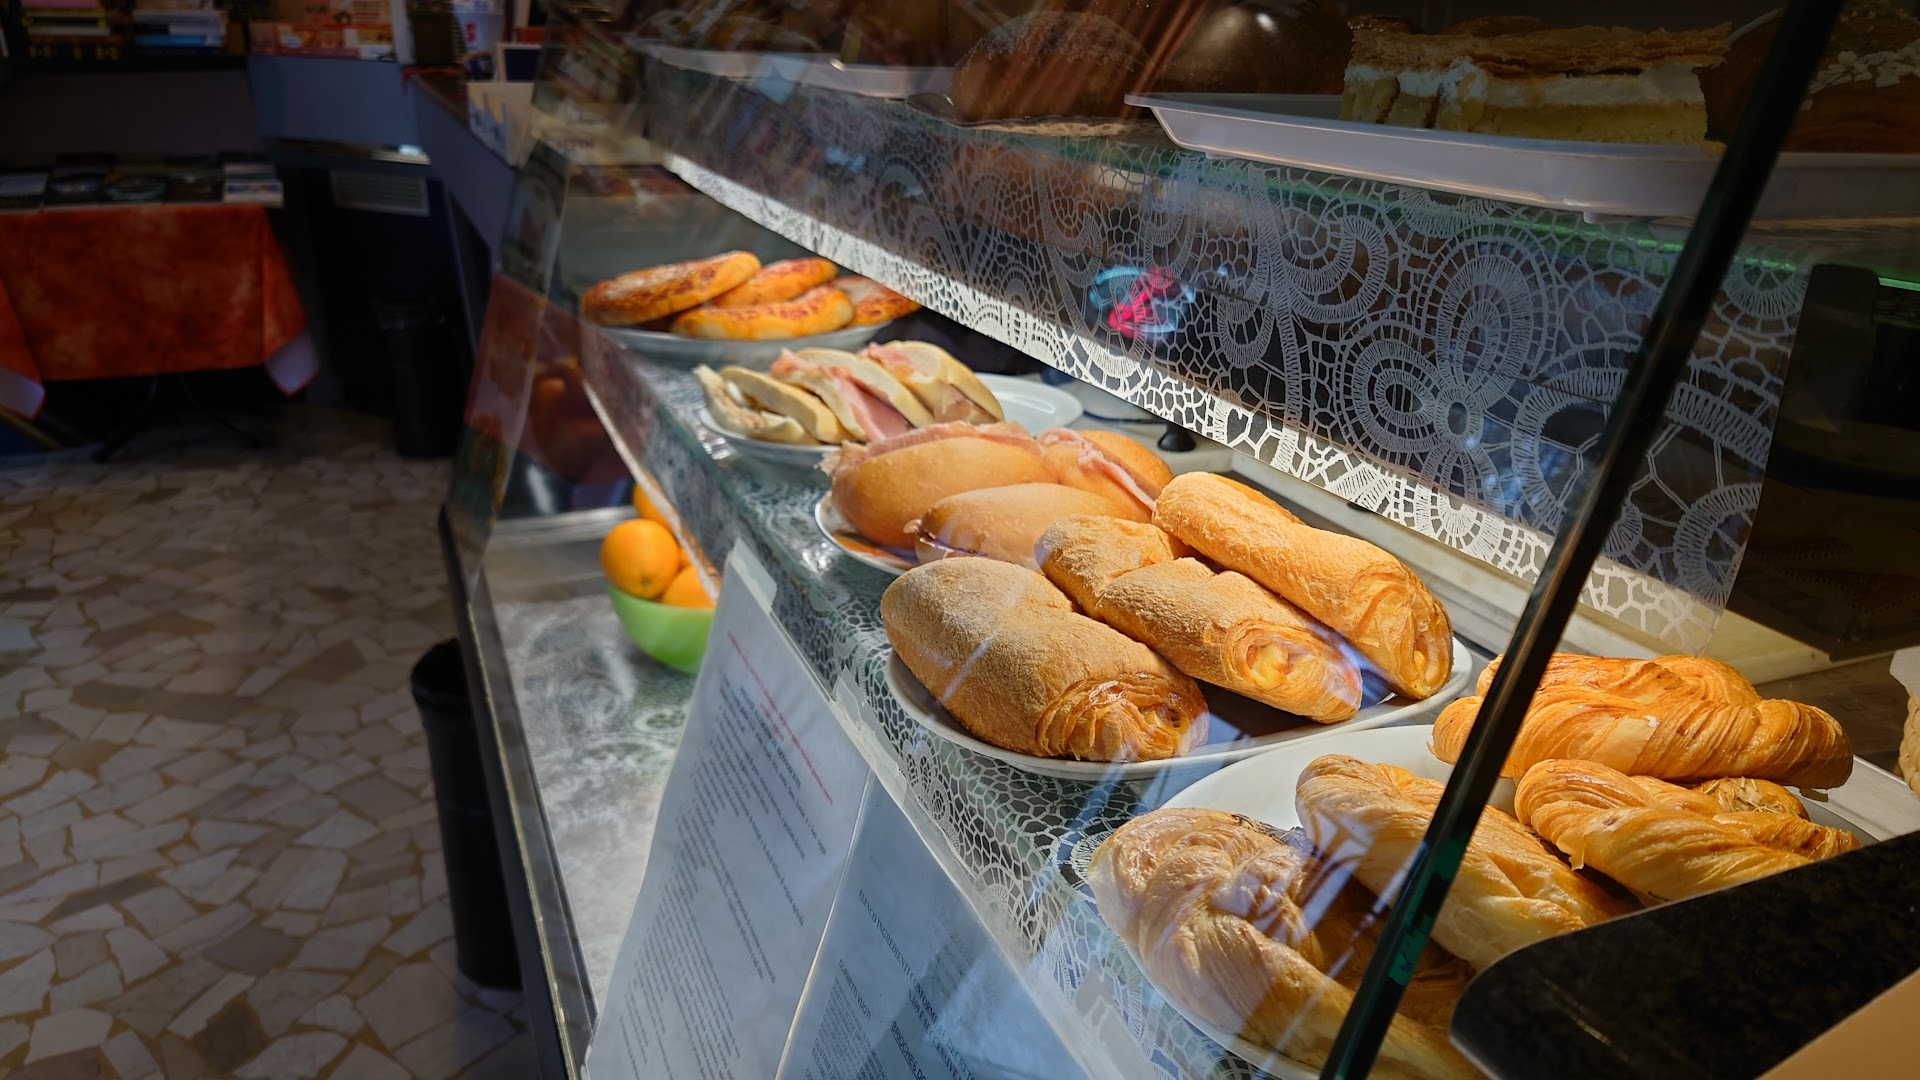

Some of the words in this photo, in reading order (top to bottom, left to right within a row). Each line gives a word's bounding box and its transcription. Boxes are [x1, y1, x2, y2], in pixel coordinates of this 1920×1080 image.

[859, 889, 878, 922] ELENCO
[876, 919, 911, 976] INGREDIENTI
[909, 972, 938, 1024] CONFORME
[857, 993, 871, 1021] VUOTI
[891, 1020, 917, 1072] BRIOCHES
